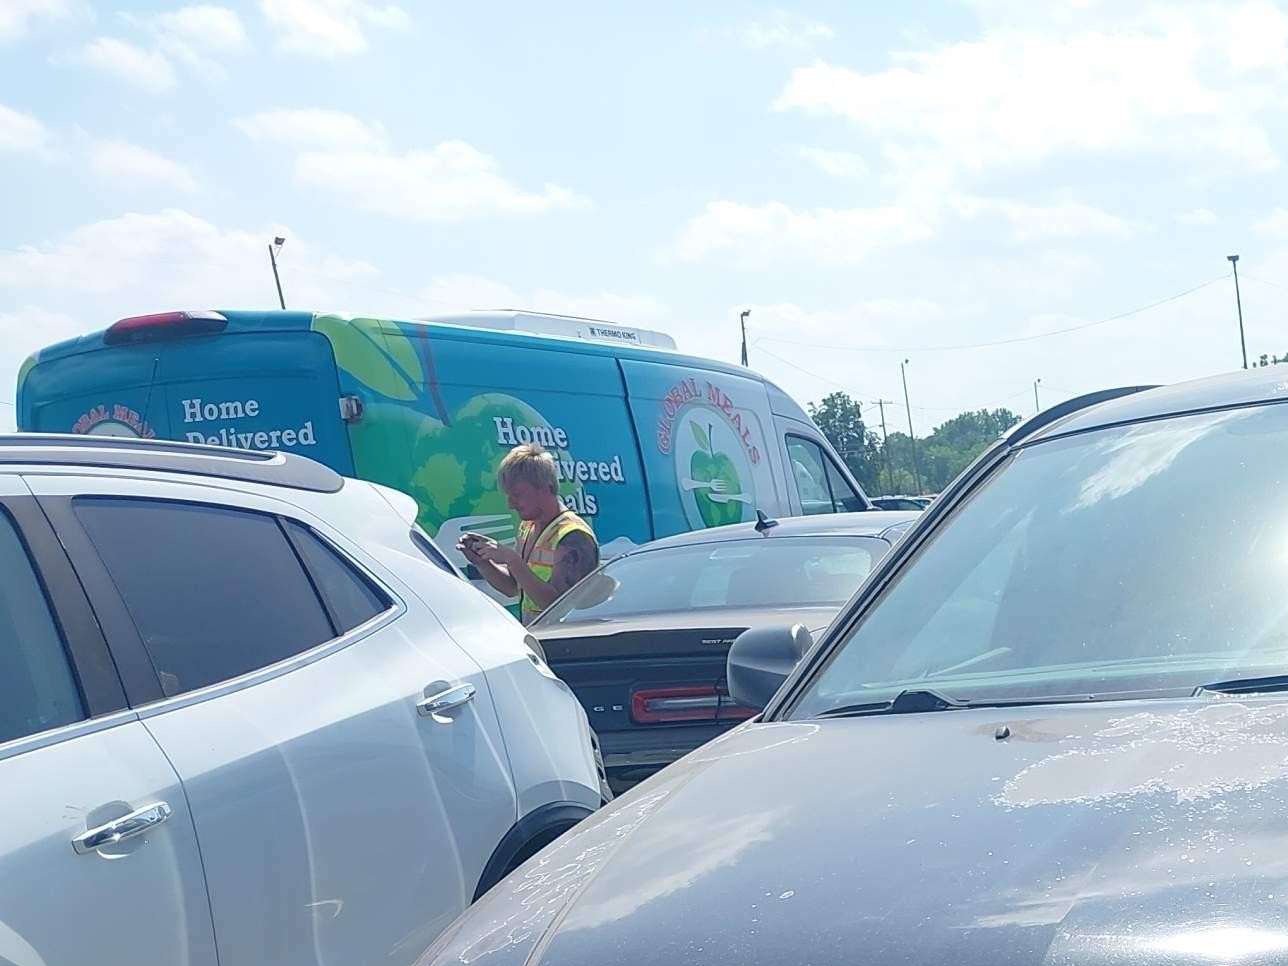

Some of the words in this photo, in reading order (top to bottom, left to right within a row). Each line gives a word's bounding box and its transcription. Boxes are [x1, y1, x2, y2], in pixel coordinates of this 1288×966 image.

[597, 328, 621, 339] THERMO
[621, 331, 637, 340] KING
[181, 399, 260, 423] Home
[657, 378, 702, 455] GLOBAL
[706, 381, 761, 465] MEALS
[492, 416, 568, 448] Home
